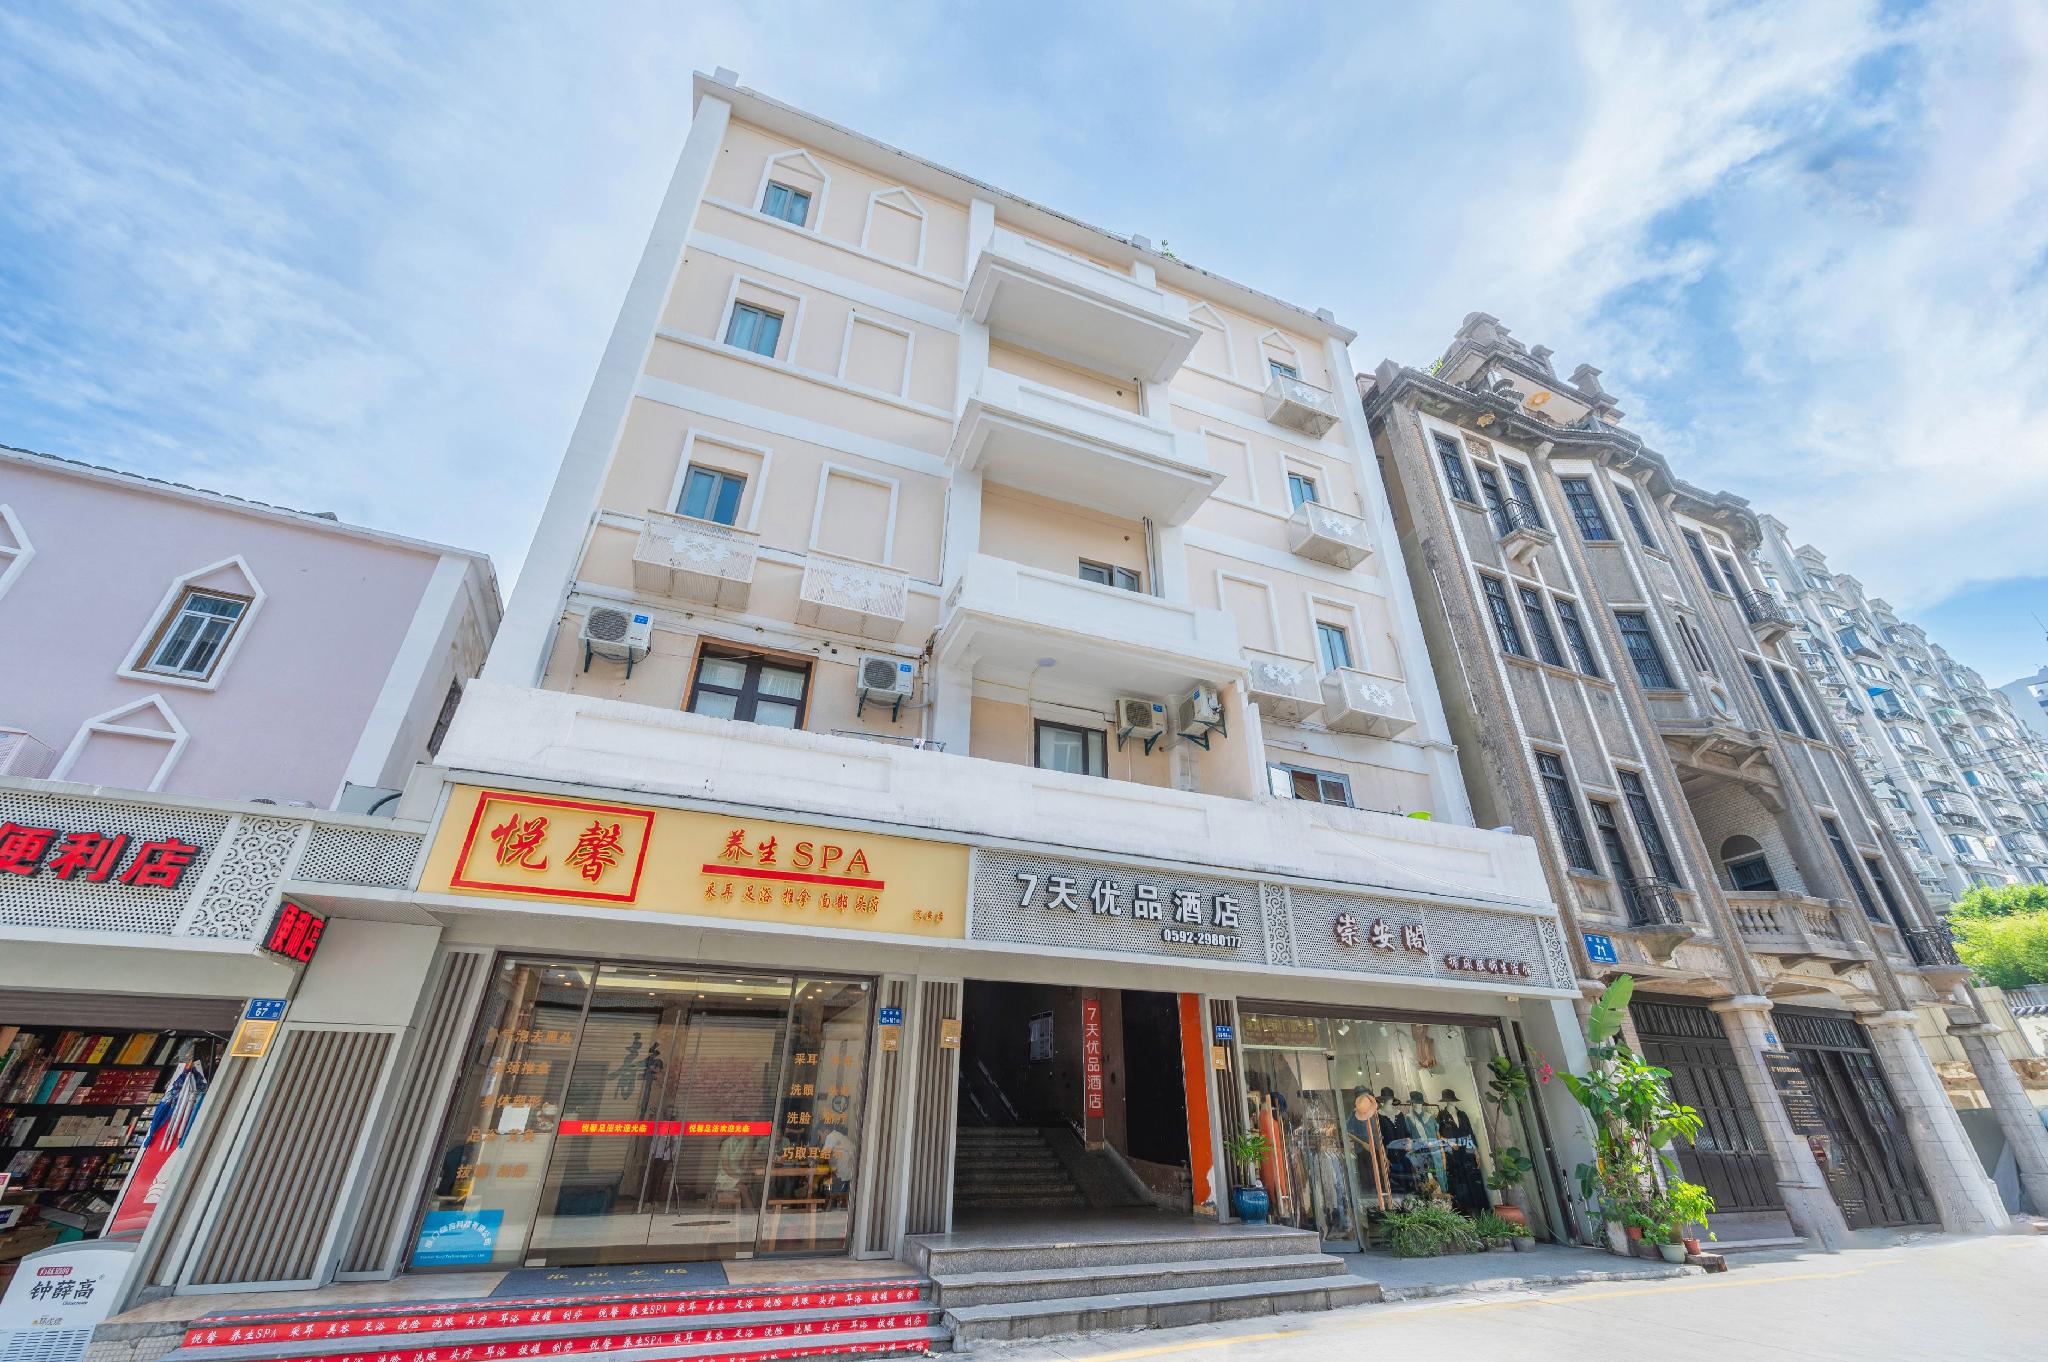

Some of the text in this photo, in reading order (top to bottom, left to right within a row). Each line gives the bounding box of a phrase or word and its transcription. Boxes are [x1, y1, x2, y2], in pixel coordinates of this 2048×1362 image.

[490, 812, 625, 884] 悦馨
[704, 881, 734, 901] 采耳
[742, 885, 773, 904] 足浴
[782, 888, 811, 908] 推拿
[818, 893, 848, 912] 面部
[1016, 873, 1240, 928] 7天优品酒店
[268, 902, 325, 963] 便利店
[1162, 929, 1242, 948] 0592-2980177
[1594, 944, 1607, 957] 71
[255, 1007, 269, 1017] 67
[794, 1053, 818, 1066] 采耳
[1086, 1007, 1102, 1109] 7天优品酒店
[790, 1083, 814, 1096] 洗眼
[786, 1111, 812, 1125] 洗脸
[31, 1279, 96, 1301] 钟薛高
